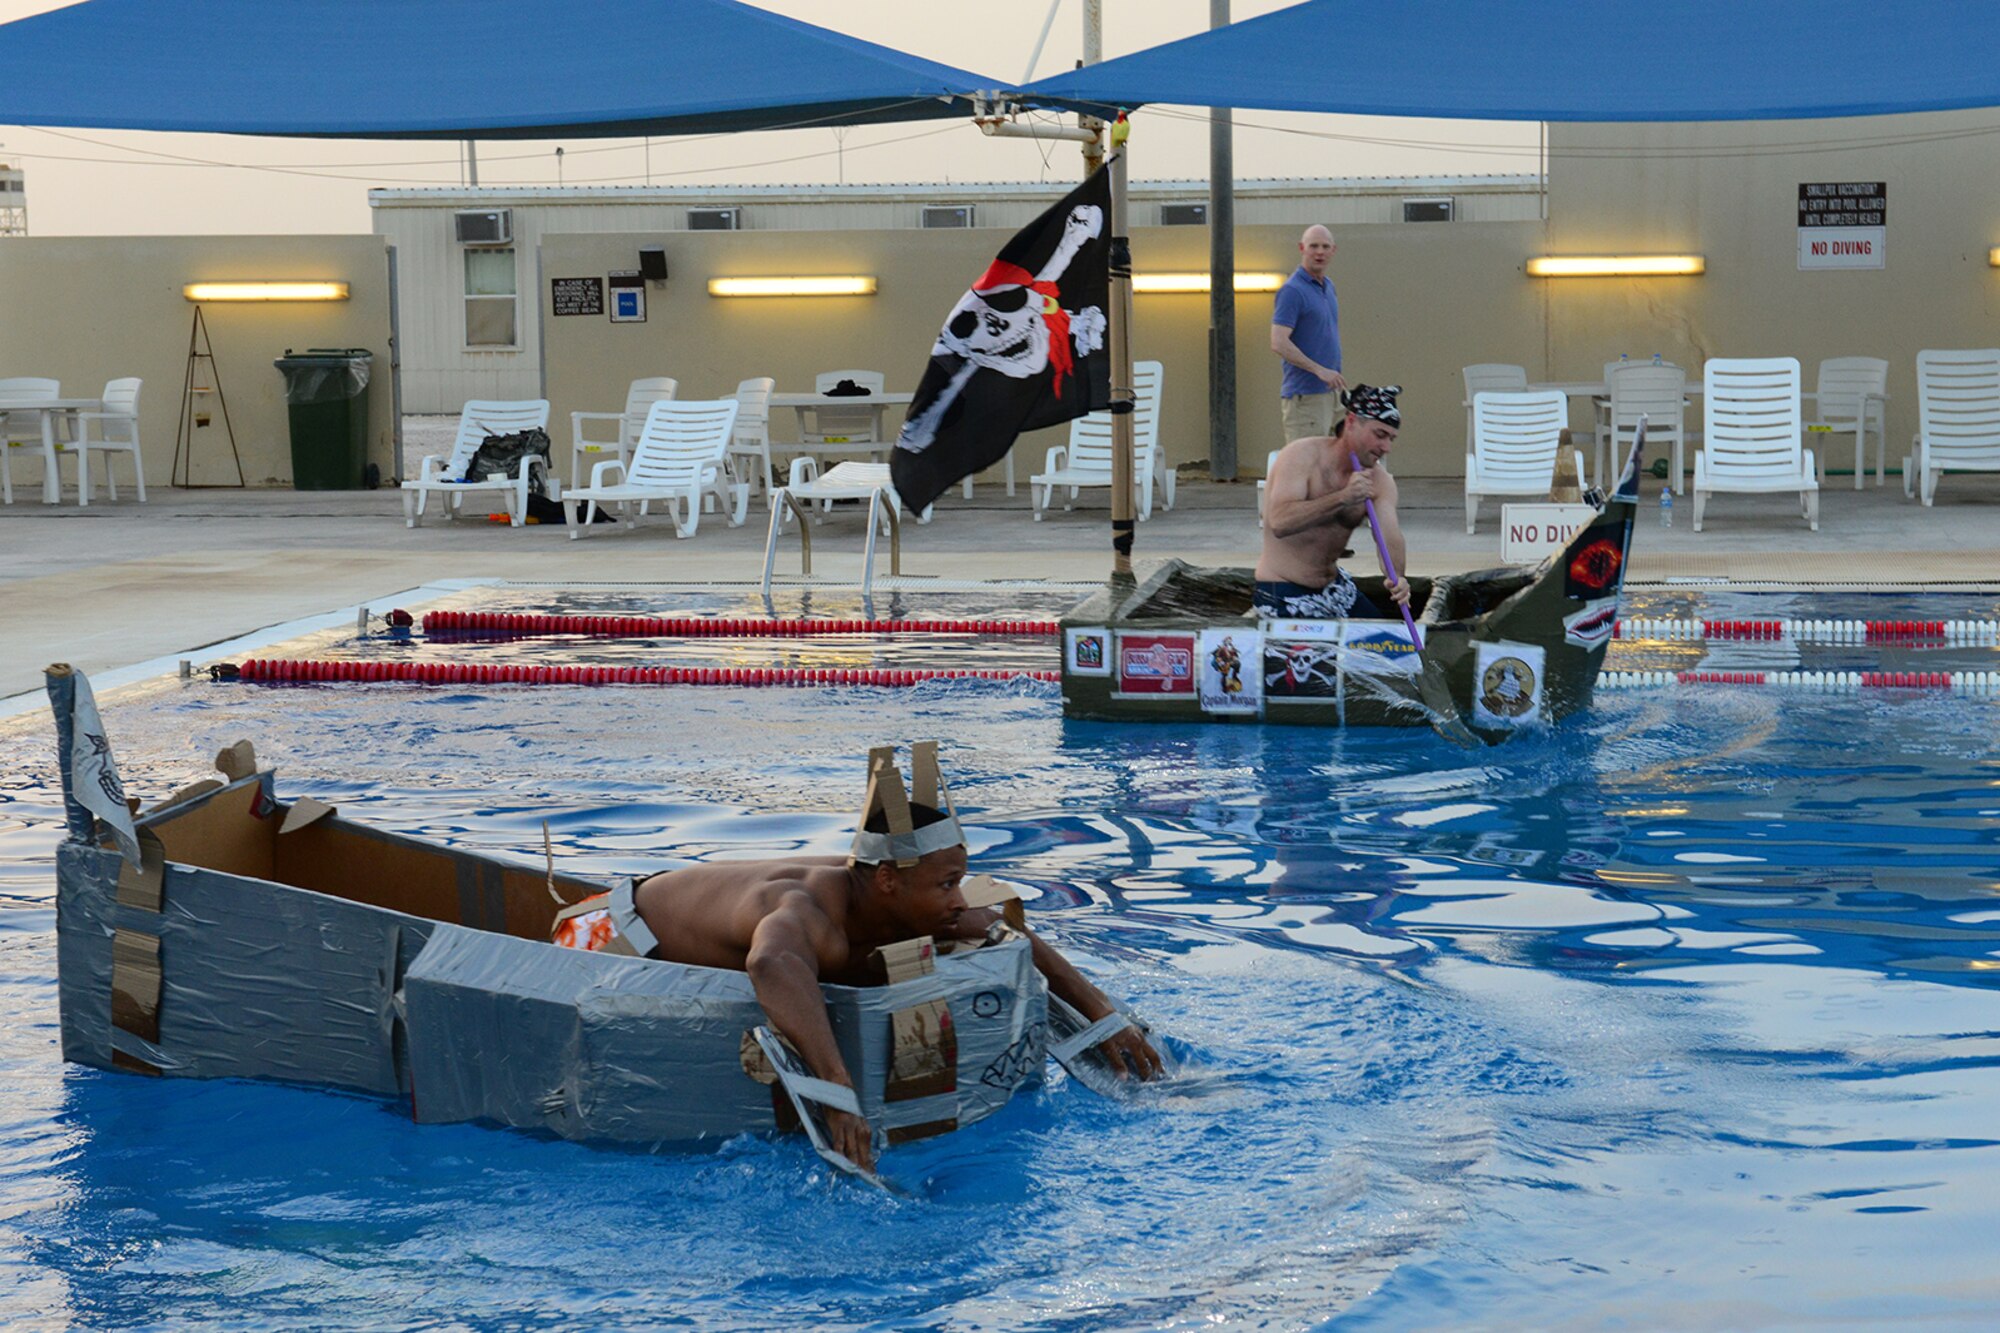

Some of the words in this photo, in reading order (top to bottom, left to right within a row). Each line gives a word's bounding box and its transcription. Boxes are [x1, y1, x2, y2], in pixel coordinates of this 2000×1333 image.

[1799, 199, 1808, 211] NO
[1809, 199, 1827, 211] ENTRY
[1843, 198, 1858, 210] POOL
[1859, 198, 1885, 209] ALLOWED
[1805, 214, 1822, 226] UNTIL
[1823, 214, 1858, 225] COMPLETELY
[1859, 213, 1881, 225] HEALED
[1811, 241, 1828, 255] NO
[1832, 241, 1872, 255] DIVING
[1510, 525, 1538, 543] NO
[1546, 525, 1580, 543] DIV
[1348, 639, 1415, 653] GOODYEAR
[1202, 694, 1229, 708] Captain
[1230, 694, 1257, 708] Morgan
